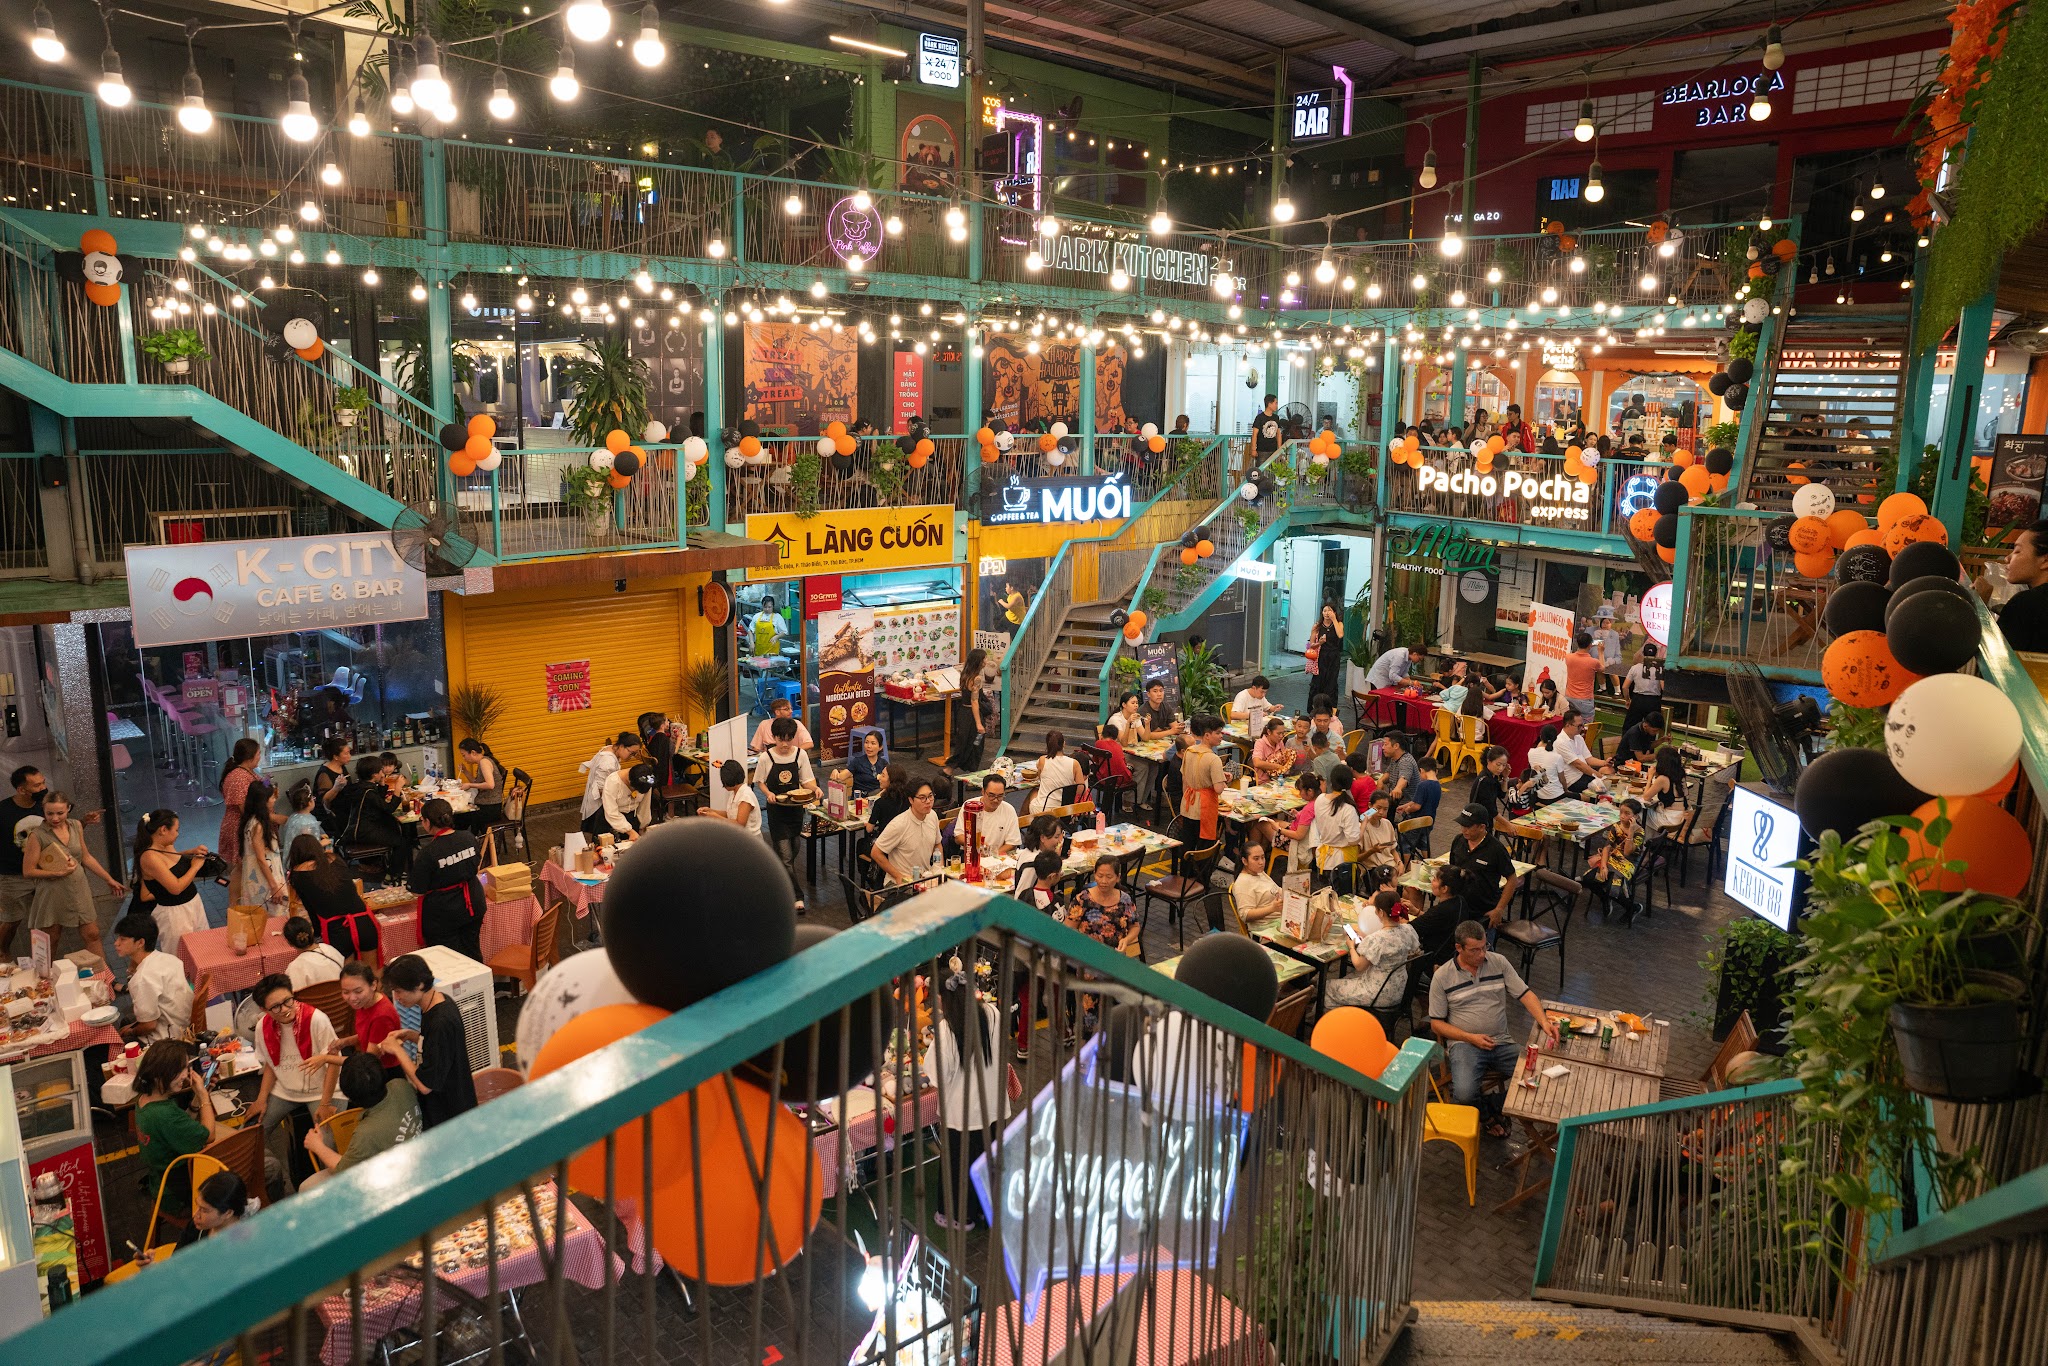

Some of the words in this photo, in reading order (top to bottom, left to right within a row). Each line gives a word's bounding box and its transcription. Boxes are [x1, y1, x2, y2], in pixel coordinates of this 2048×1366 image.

[929, 71, 952, 80] FOOD
[983, 97, 1001, 107] ACOS
[1296, 93, 1319, 107] 24/7
[1294, 106, 1329, 137] BAR
[1695, 103, 1747, 127] BAR
[836, 239, 853, 251] Pink
[1039, 233, 1109, 274] DARK
[1113, 242, 1208, 286] KITCHEN
[1210, 256, 1234, 271] 2d
[763, 350, 796, 361] TRICK
[1049, 347, 1074, 361] HAPPY
[1773, 351, 1817, 368] WA
[773, 370, 786, 379] OR
[1041, 363, 1080, 378] HALLOWEEN
[763, 389, 796, 399] TREAT
[1418, 465, 1497, 497] Pacho
[1503, 471, 1590, 503] Pocha
[1042, 472, 1131, 523] MUỐI
[991, 512, 1020, 522] COFFEE
[1020, 512, 1026, 520] &
[1026, 511, 1040, 520] TEA
[1531, 505, 1589, 520] express
[806, 524, 874, 556] LÀNG
[879, 513, 944, 551] CUỐN
[979, 559, 1006, 575] OPEN
[1391, 561, 1422, 573] HEALTHY
[1424, 566, 1445, 576] FOOD
[257, 584, 325, 608] CAFE
[330, 583, 348, 601] &
[354, 578, 404, 599] BAR
[1646, 597, 1661, 609] AL
[257, 607, 301, 626] 낮에는
[307, 605, 339, 621] 카페,
[343, 602, 384, 618] 밤에는
[1652, 612, 1669, 621] LEB
[1646, 621, 1669, 631] REST
[1532, 630, 1568, 651] HANDMADE
[1532, 642, 1567, 661] WORKSHOP
[553, 672, 584, 682] COMING
[187, 690, 213, 698] OPEN
[558, 683, 580, 692] SOON
[834, 680, 863, 693] Authentic
[826, 692, 855, 703] MOROCCAN
[855, 690, 871, 698] BITES
[1732, 864, 1765, 907] KEBAB
[1767, 885, 1782, 918] 88
[395, 1110, 413, 1142] DAZE
